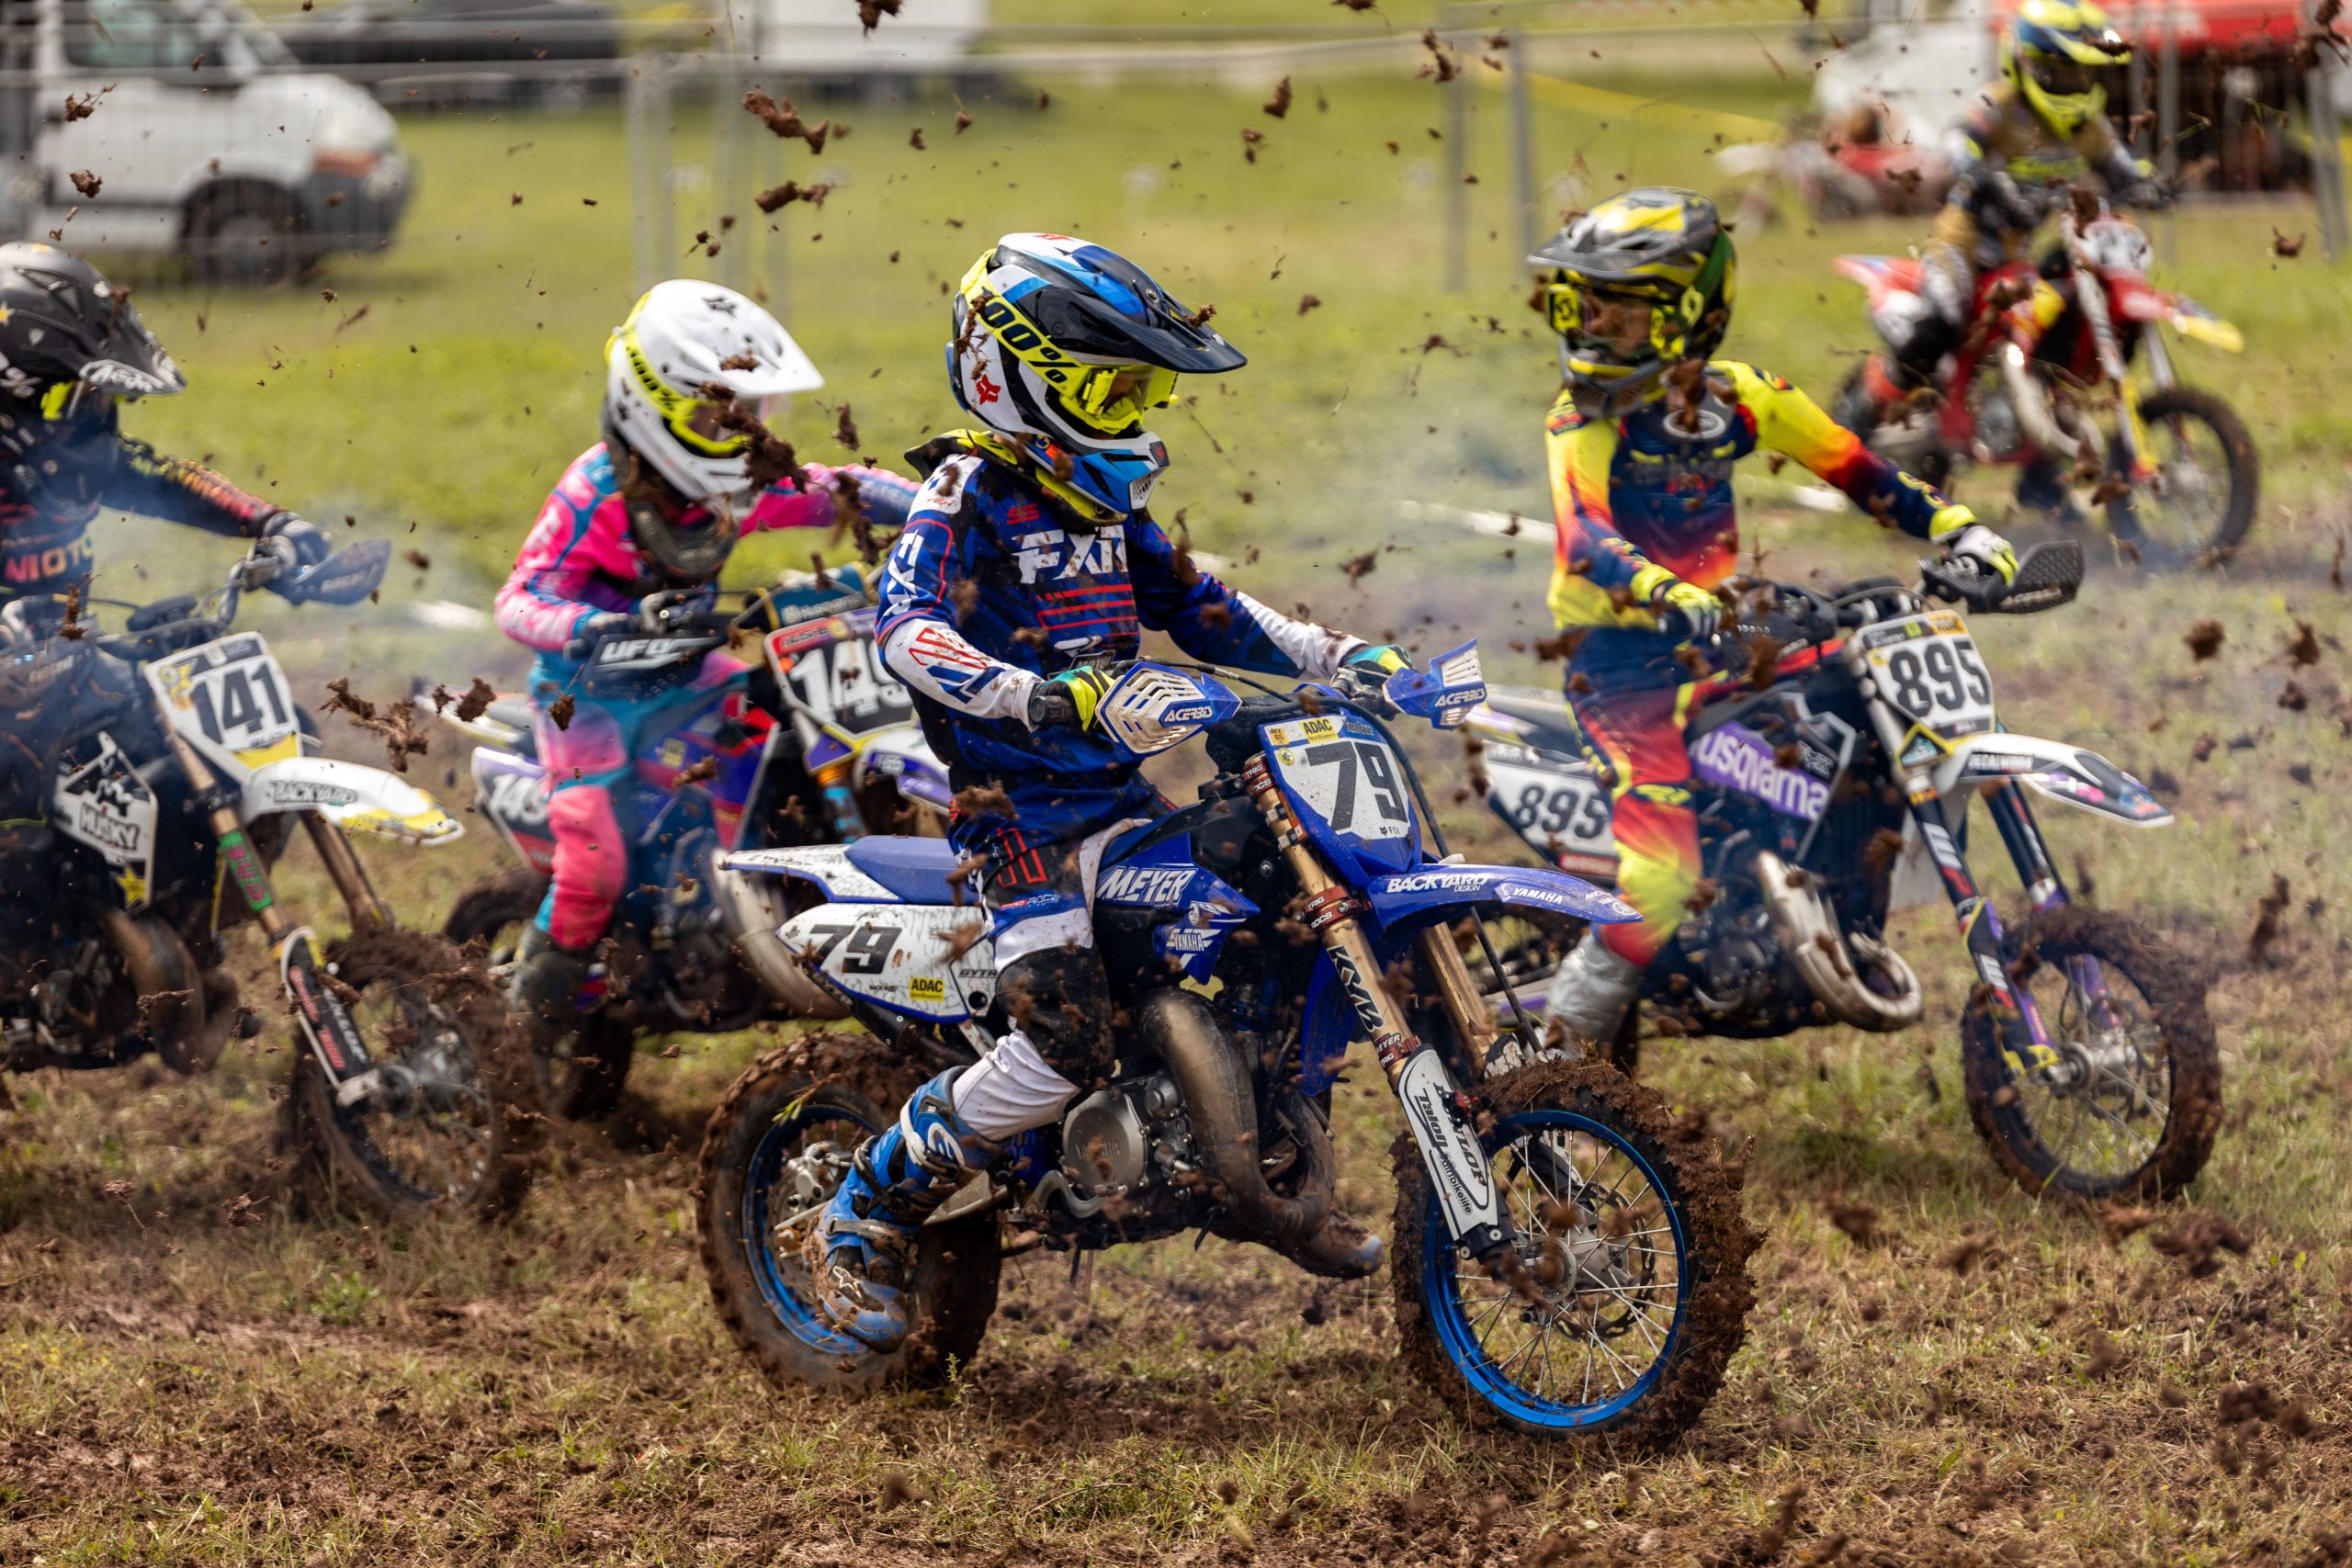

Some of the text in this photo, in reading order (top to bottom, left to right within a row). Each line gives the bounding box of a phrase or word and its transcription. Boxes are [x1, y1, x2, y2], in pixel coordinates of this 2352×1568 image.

[979, 286, 1080, 384] 00%
[598, 638, 673, 663] UFO
[1434, 688, 1487, 708] ACERBIS
[1889, 640, 1992, 718] 895
[189, 662, 289, 746] 141
[1303, 718, 1333, 736] ADAC
[1305, 741, 1408, 831] 79
[1515, 784, 1606, 840] 895
[1095, 867, 1197, 906] MEYER
[1385, 872, 1491, 893] BACKYARD
[1513, 887, 1564, 904] YAMAHA
[809, 923, 903, 974] 79
[1172, 932, 1205, 952] YAMAHA
[910, 978, 944, 993] ADAC
[1418, 1087, 1449, 1148] Talon
